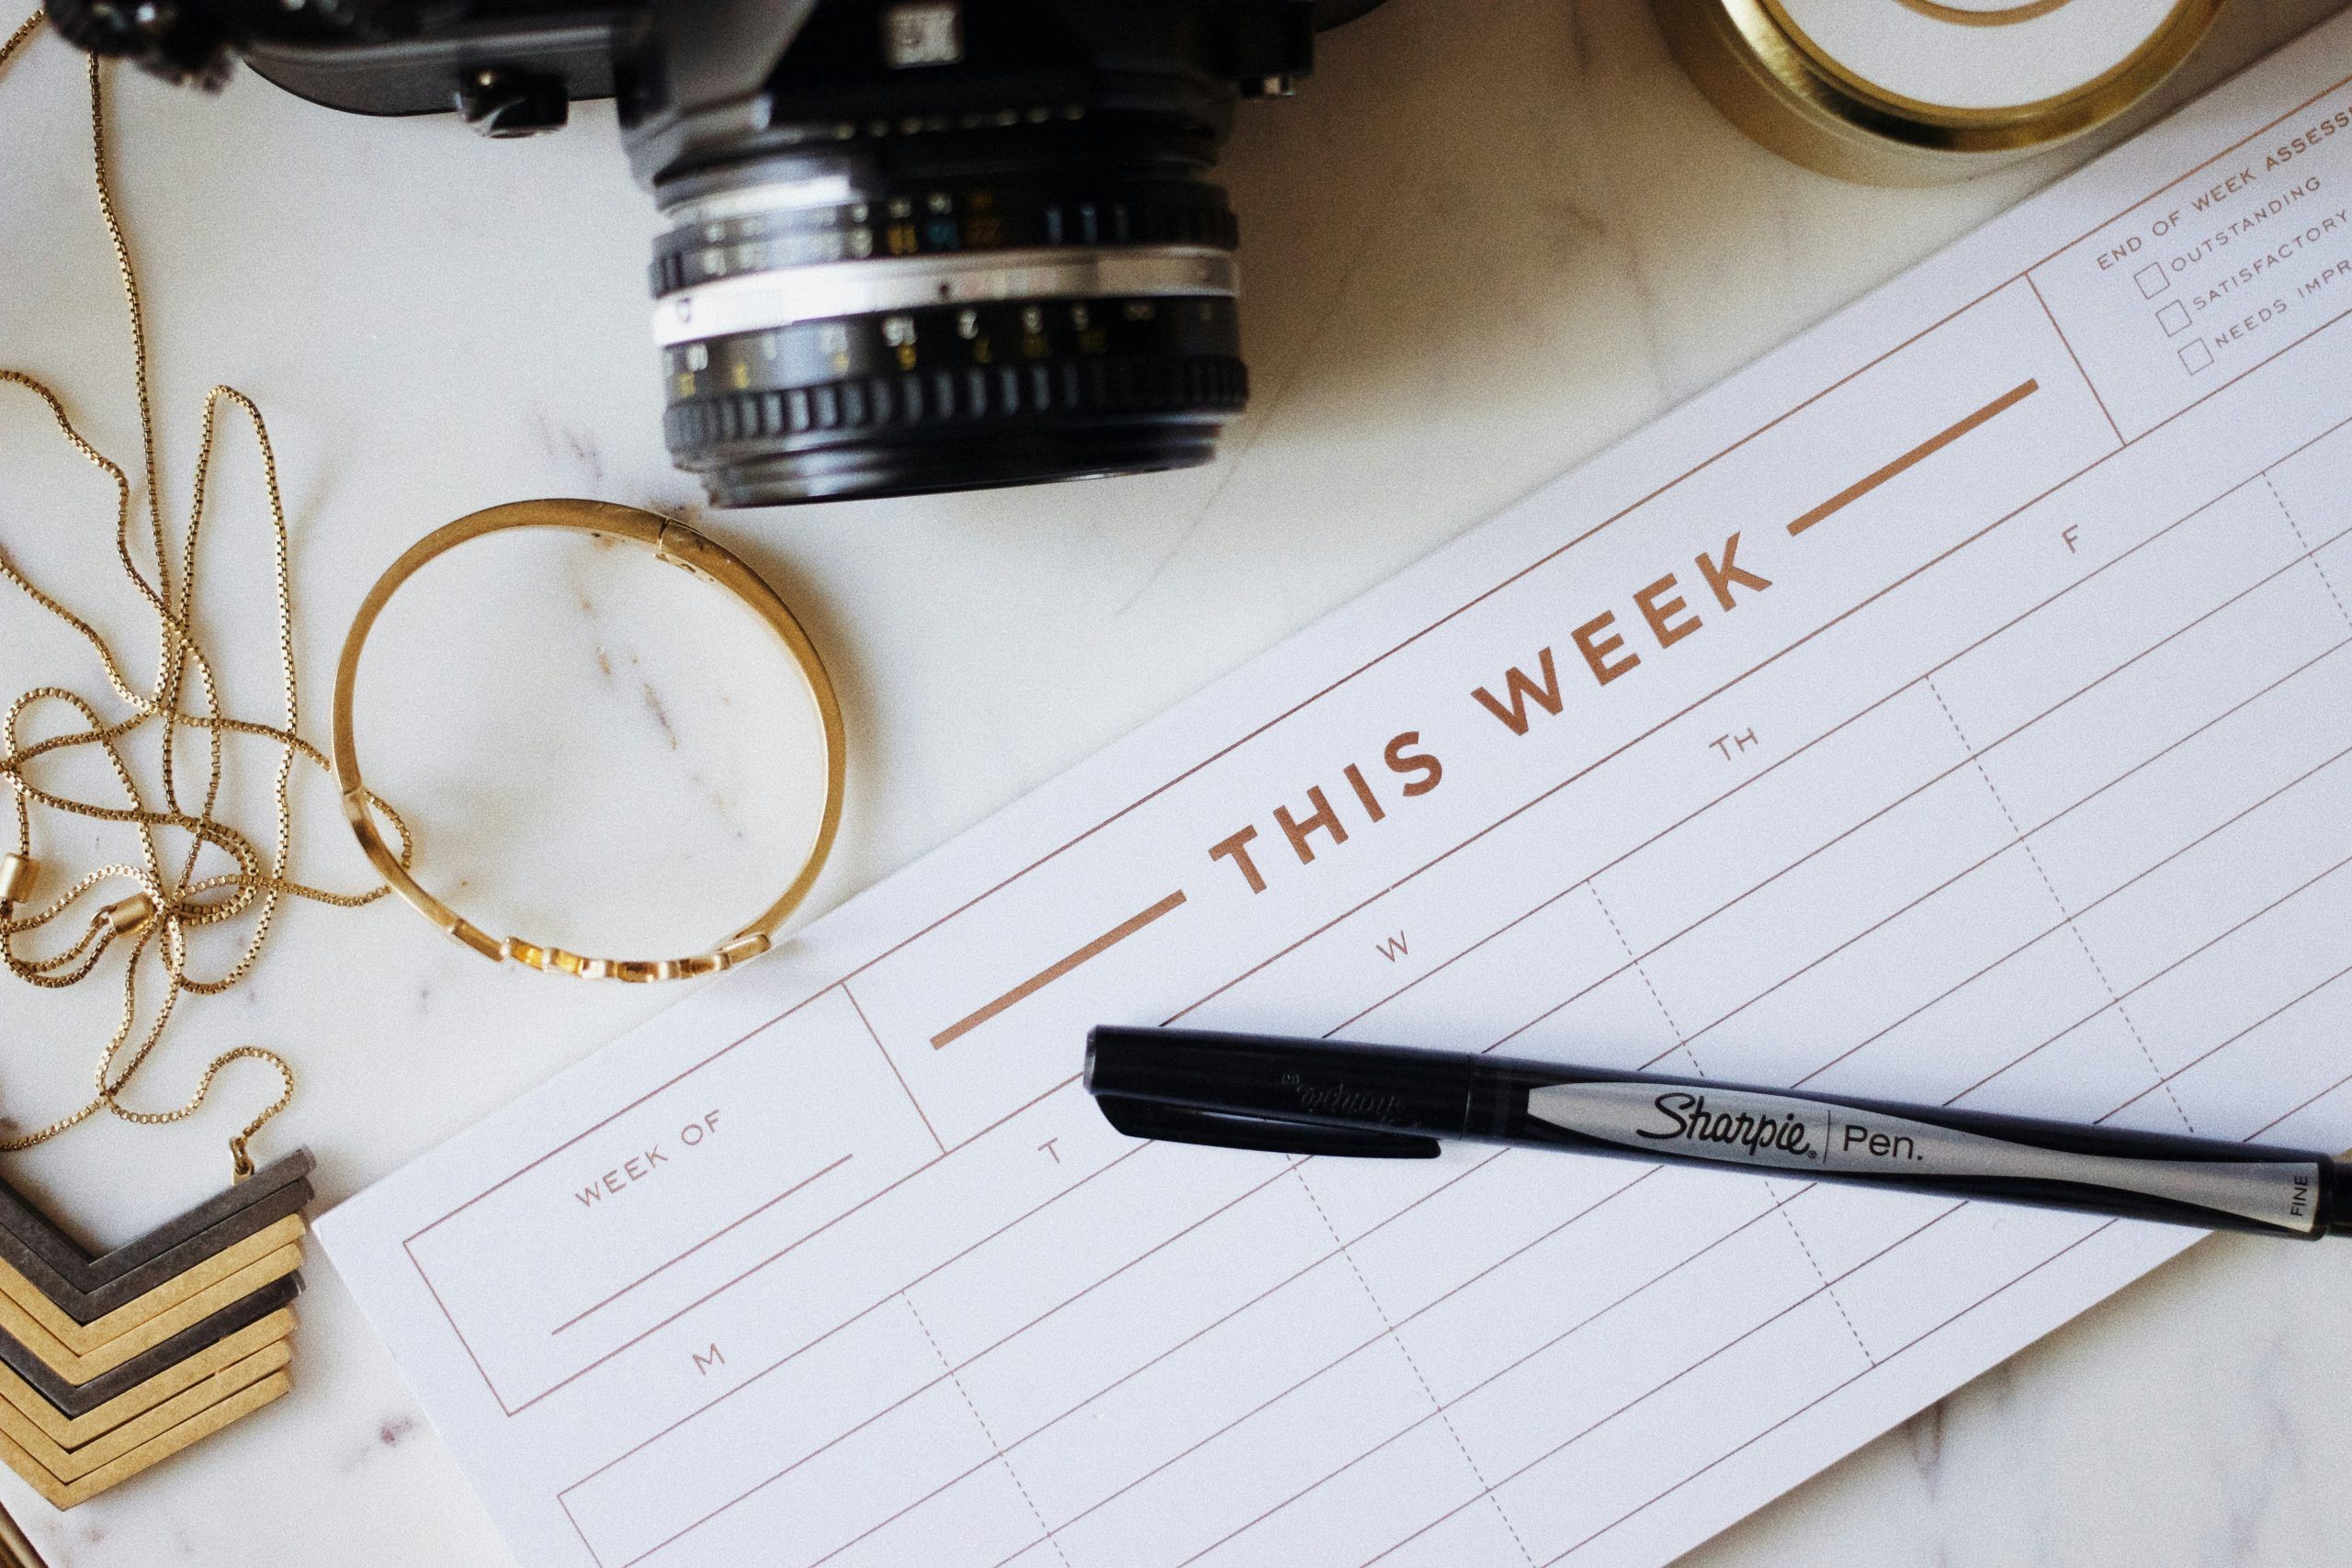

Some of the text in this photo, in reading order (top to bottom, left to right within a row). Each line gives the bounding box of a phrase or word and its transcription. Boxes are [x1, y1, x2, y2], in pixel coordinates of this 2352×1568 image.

[2097, 106, 2352, 270] END OF WEEK ASSESS
[2171, 176, 2321, 272] OUTSTANDING
[2192, 209, 2346, 310] SATISFACTORY
[2215, 299, 2287, 348] NEEDS
[2062, 524, 2078, 554] F
[1208, 531, 1773, 895] THIS WEEK
[1708, 727, 1759, 762] TH
[1375, 930, 1409, 963] W
[574, 1109, 720, 1208] WEEK OF
[1037, 1137, 1060, 1164] T
[1842, 1123, 1924, 1162] Pen.
[2290, 1176, 2309, 1217] FINE
[692, 1342, 726, 1376] M
